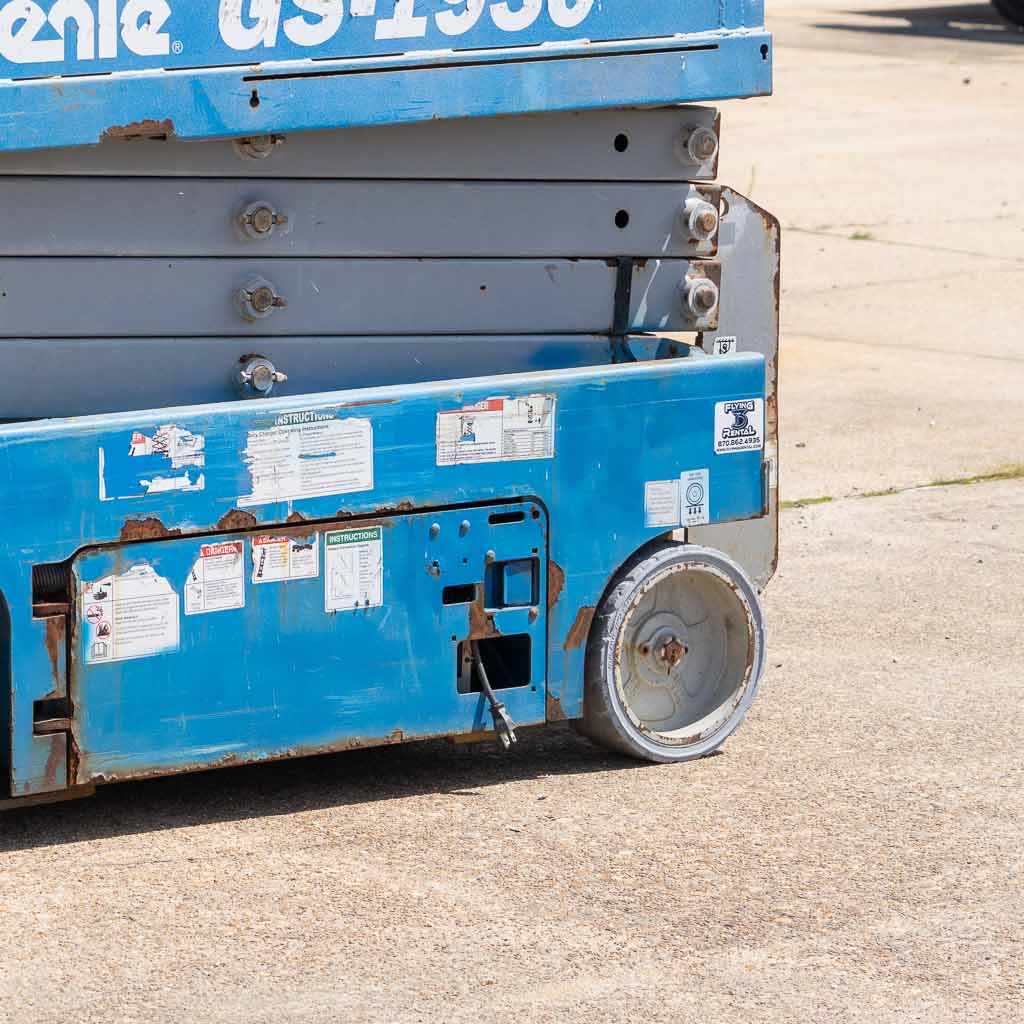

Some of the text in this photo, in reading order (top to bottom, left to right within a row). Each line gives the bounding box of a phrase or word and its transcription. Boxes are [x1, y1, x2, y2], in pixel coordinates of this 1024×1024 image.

[725, 401, 754, 414] FLYING
[723, 426, 756, 438] RENTAL
[329, 530, 378, 544] INSTRUCTIONS
